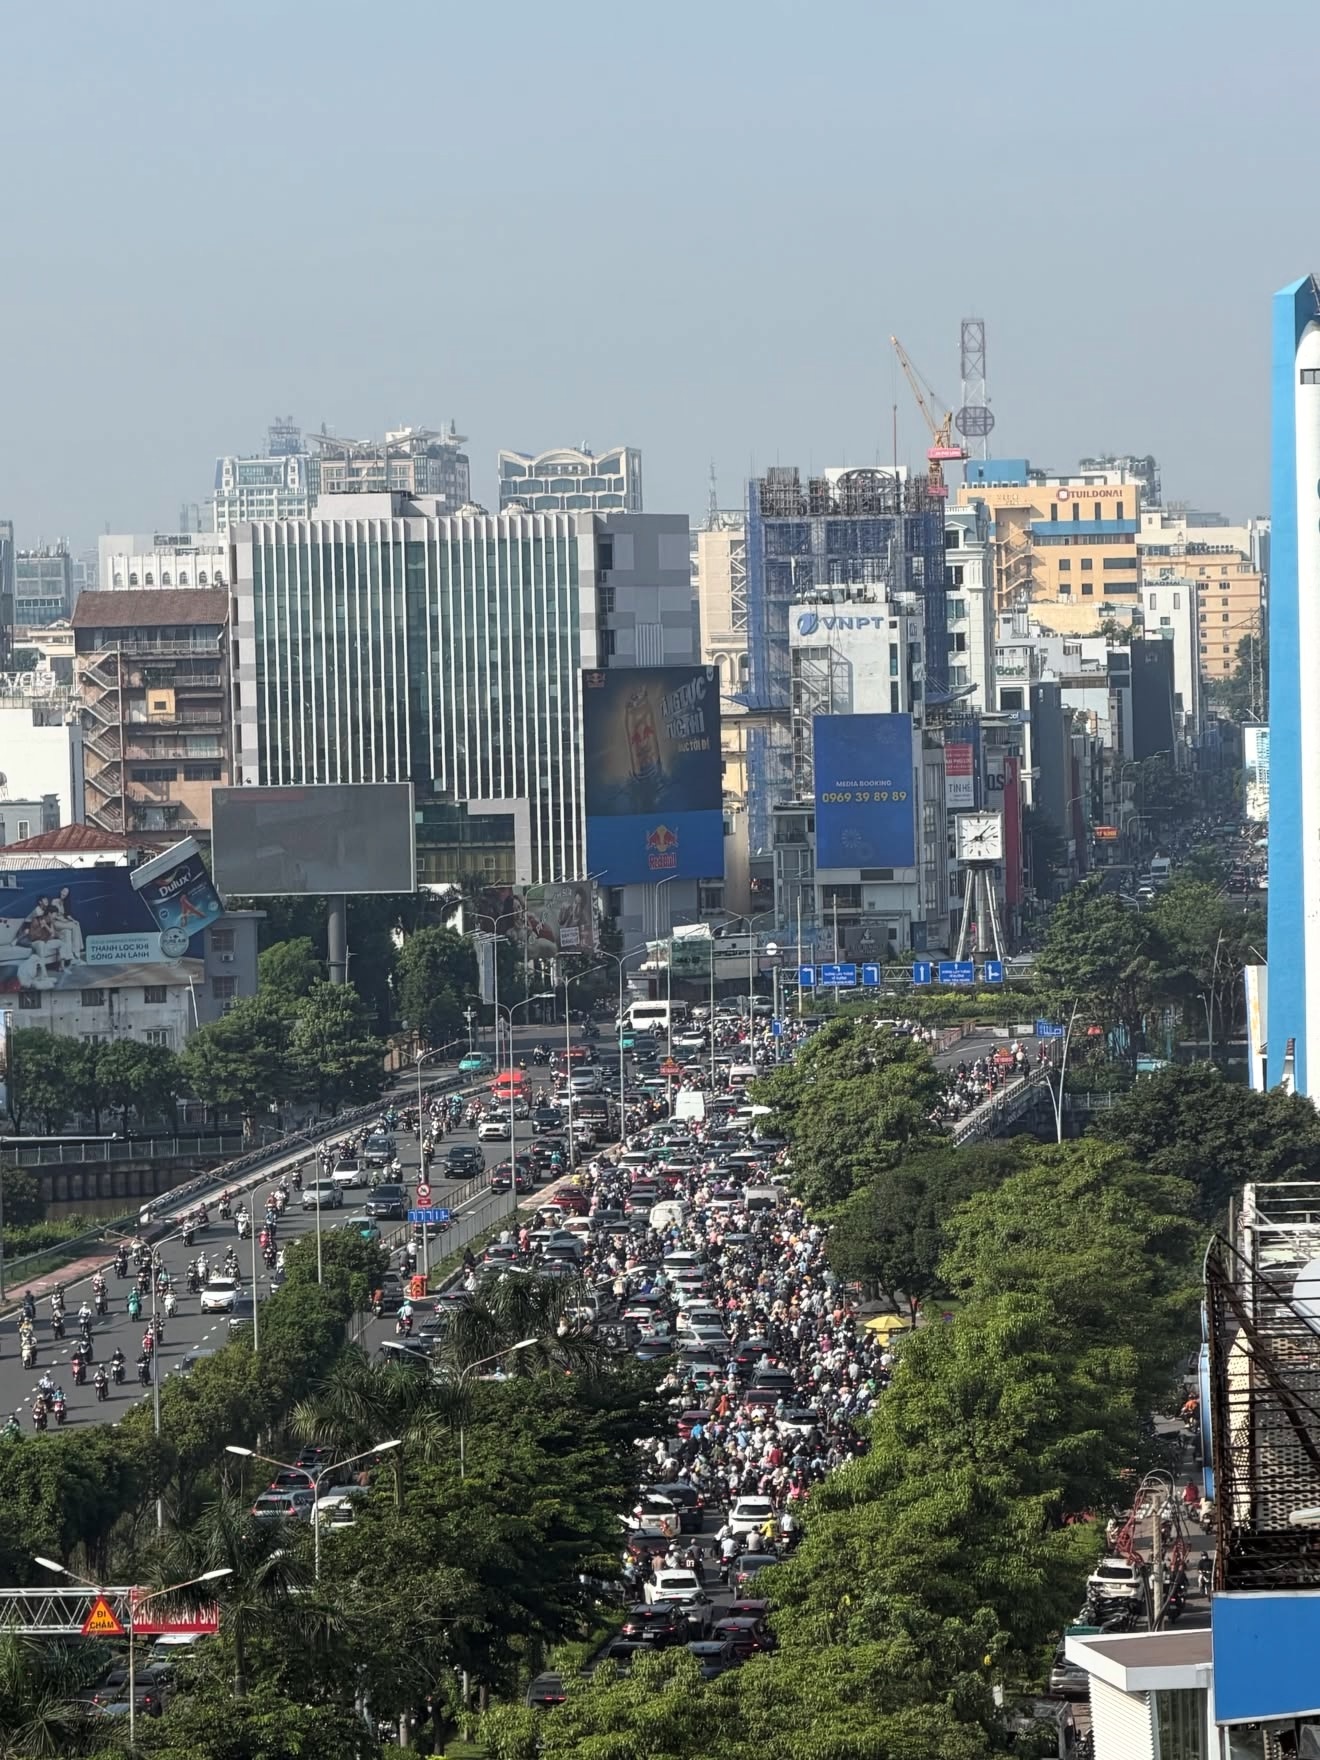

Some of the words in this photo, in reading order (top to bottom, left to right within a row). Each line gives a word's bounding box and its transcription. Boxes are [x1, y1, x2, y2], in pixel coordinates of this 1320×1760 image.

[819, 615, 885, 630] VNPT
[836, 780, 859, 788] MEDIA
[822, 792, 851, 803] 0969
[855, 792, 870, 802] 39
[874, 791, 889, 802] 89
[892, 791, 907, 801] 89
[158, 875, 190, 897] Dulux
[91, 944, 118, 953] THANH
[97, 1610, 106, 1618] ĐI
